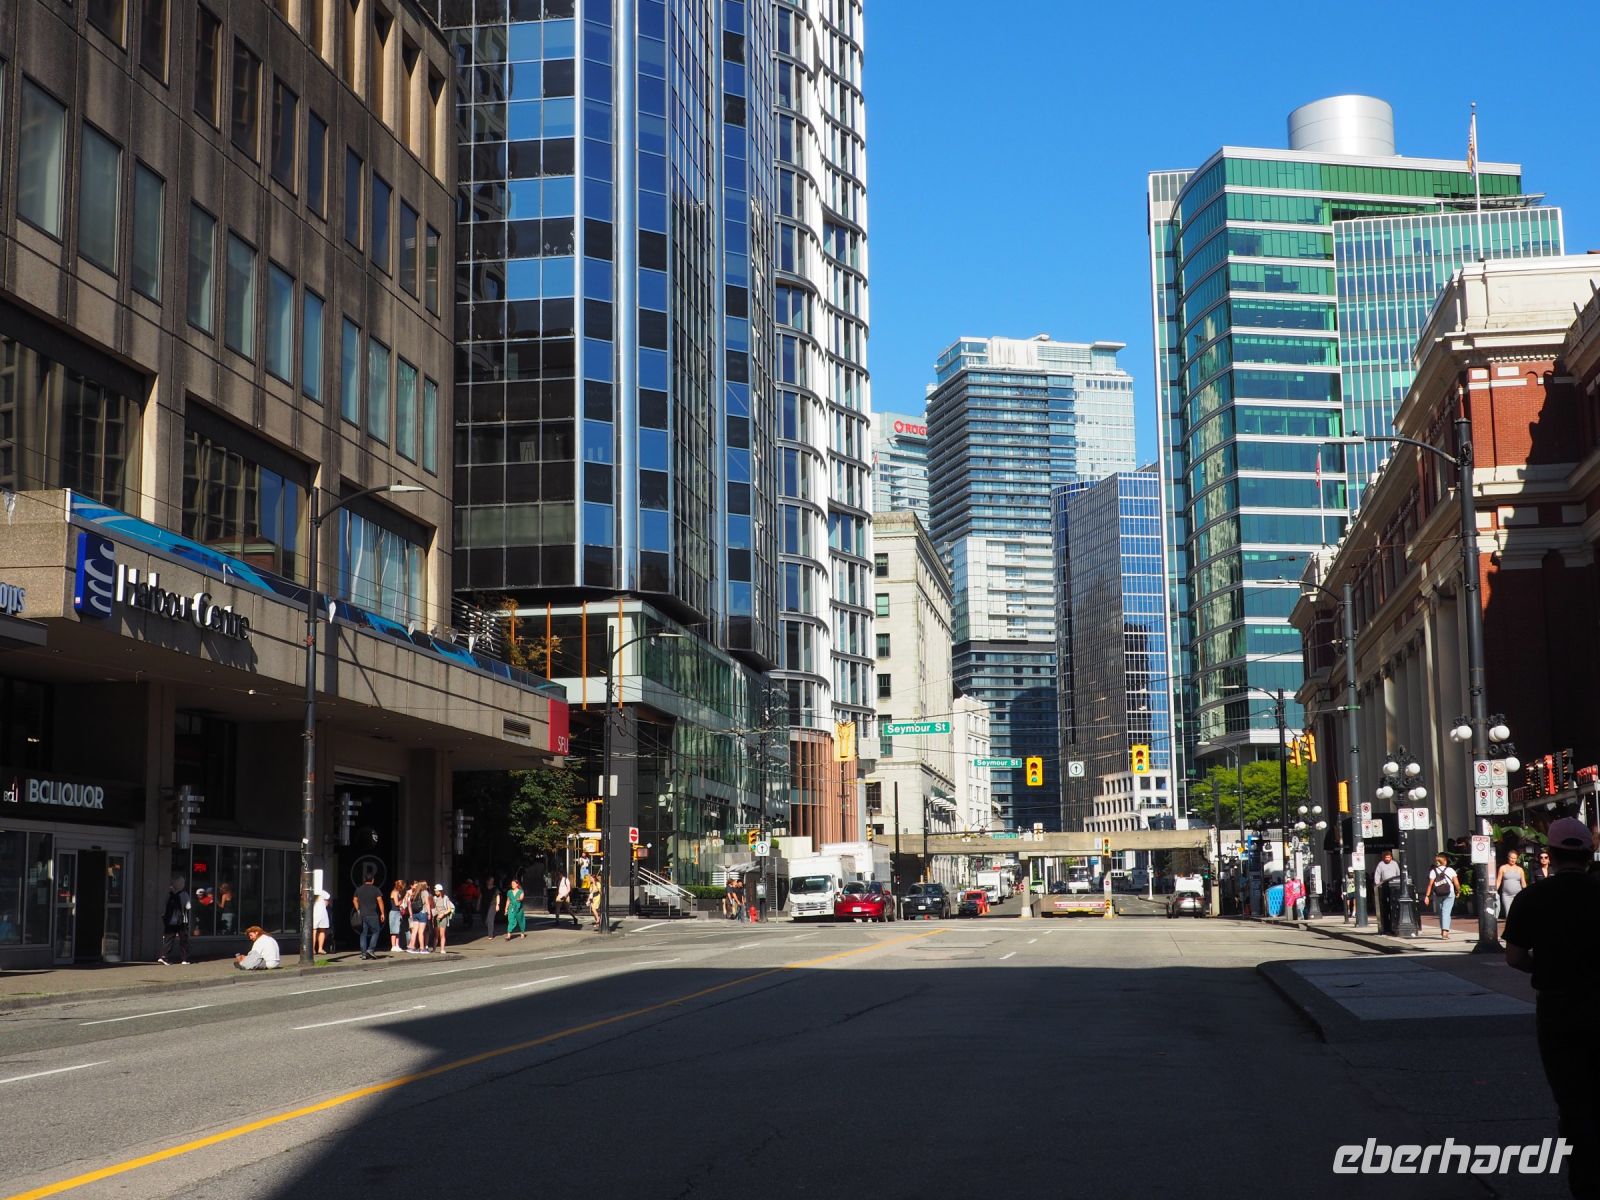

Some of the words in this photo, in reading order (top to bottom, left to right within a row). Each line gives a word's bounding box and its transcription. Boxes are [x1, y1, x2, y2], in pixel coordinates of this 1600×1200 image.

[116, 563, 194, 622] Harbour
[192, 592, 250, 640] Centre
[887, 724, 931, 734] Seymour
[934, 722, 946, 732] St
[557, 735, 569, 753] SFU
[976, 759, 1007, 767] Seymour
